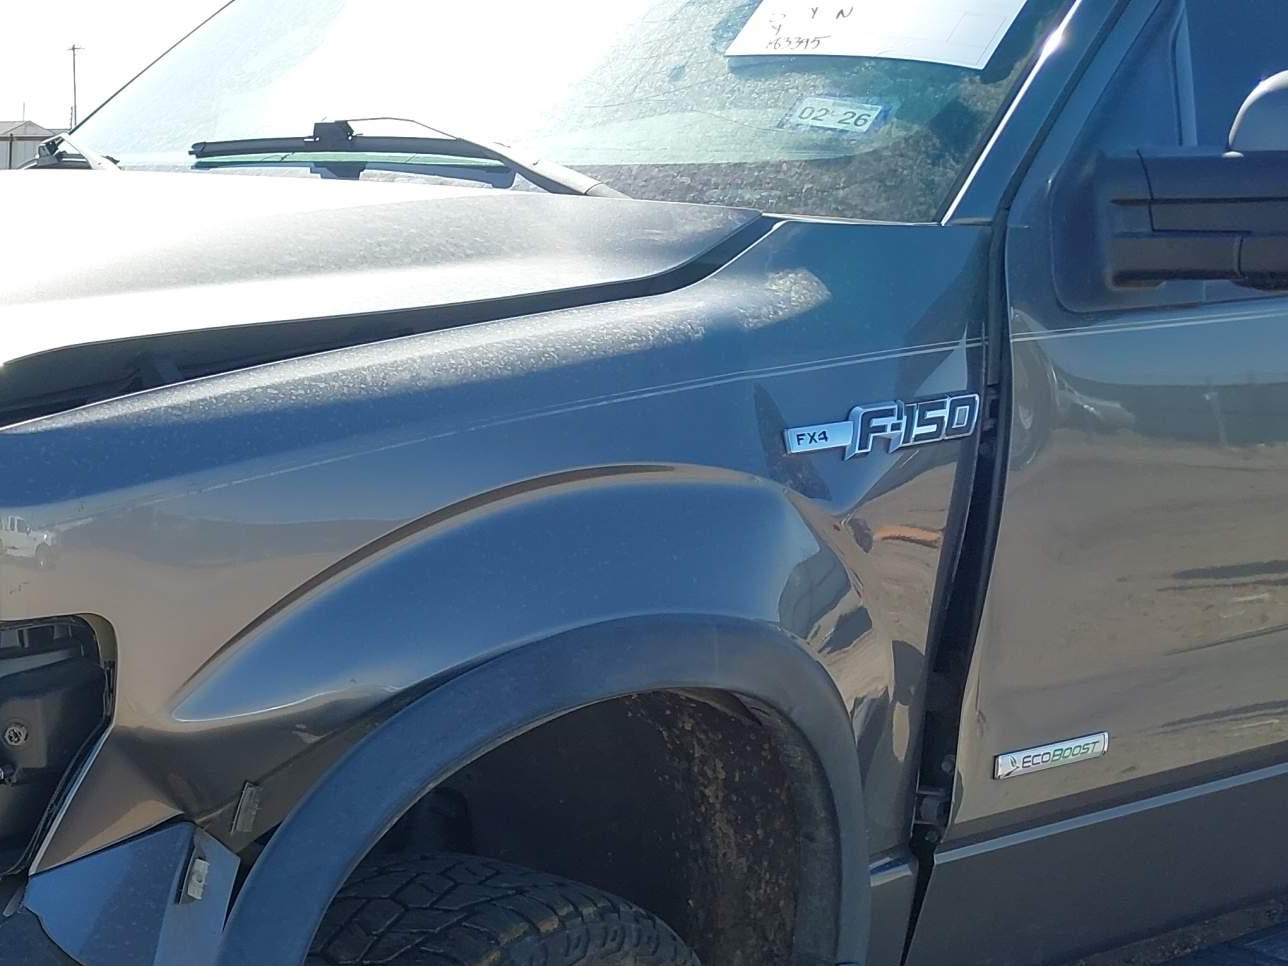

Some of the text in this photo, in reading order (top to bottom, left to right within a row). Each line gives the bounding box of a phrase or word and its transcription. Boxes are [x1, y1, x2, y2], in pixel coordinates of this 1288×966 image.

[798, 106, 871, 127] 02 26
[796, 430, 829, 446] FX4
[1021, 741, 1100, 769] ECOBOOST
